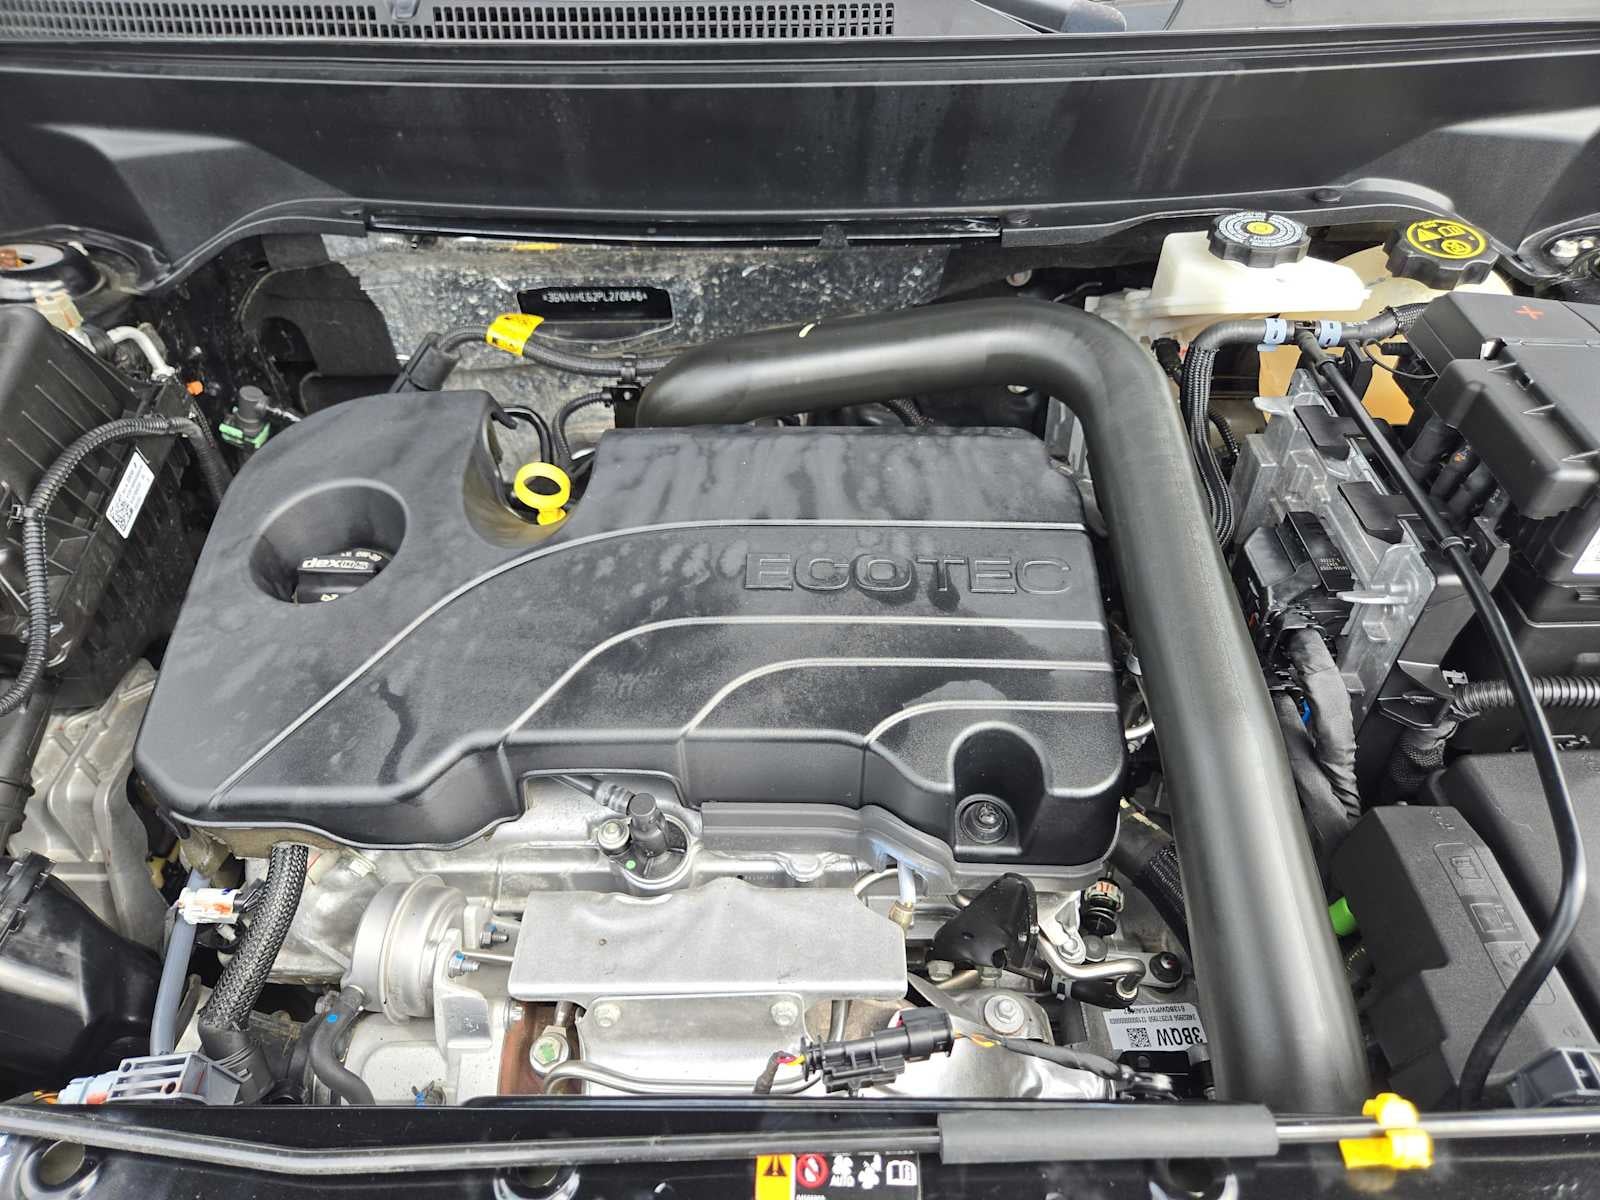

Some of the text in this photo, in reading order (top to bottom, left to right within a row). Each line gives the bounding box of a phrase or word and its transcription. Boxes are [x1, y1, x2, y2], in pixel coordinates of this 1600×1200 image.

[302, 557, 369, 570] dexos
[744, 552, 1072, 594] ECOTEC
[1156, 1026, 1203, 1047] 3BQW
